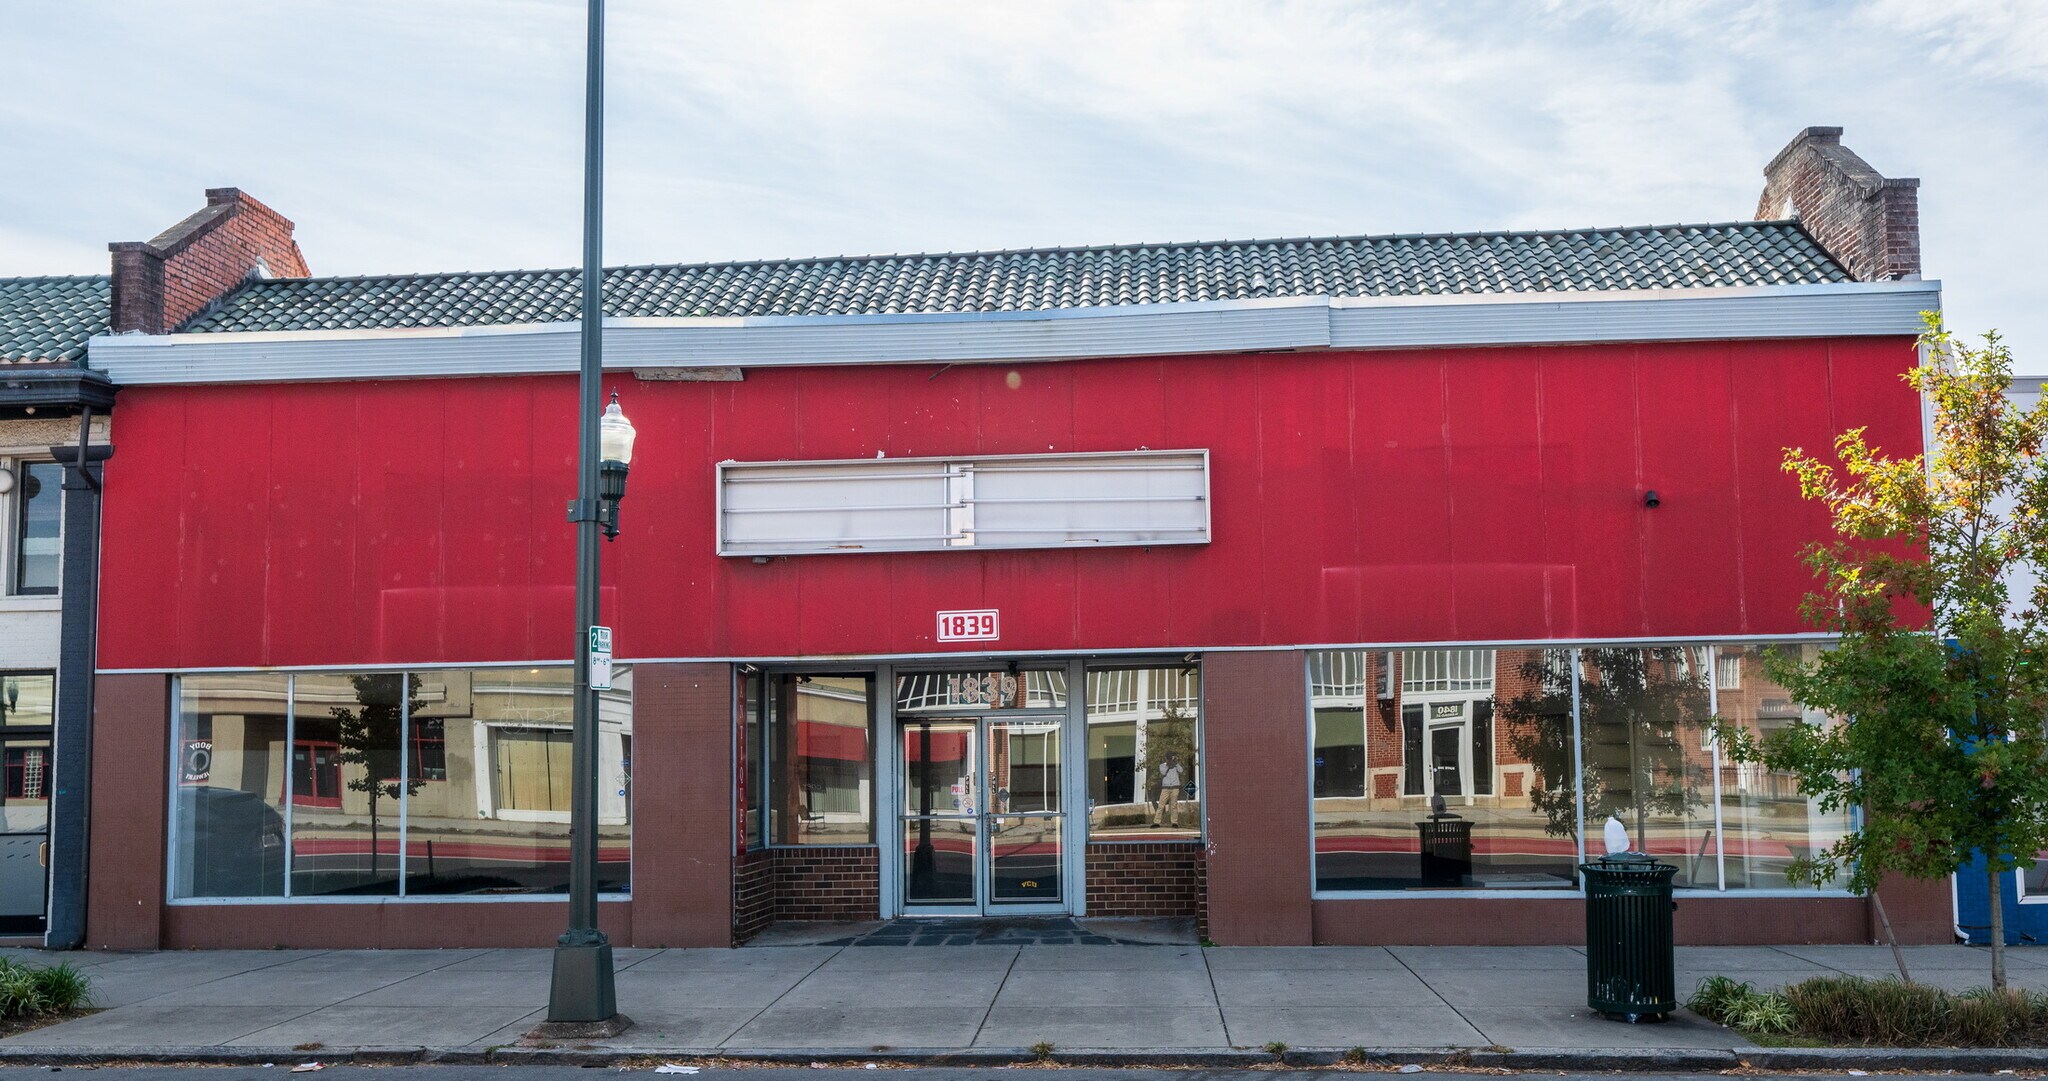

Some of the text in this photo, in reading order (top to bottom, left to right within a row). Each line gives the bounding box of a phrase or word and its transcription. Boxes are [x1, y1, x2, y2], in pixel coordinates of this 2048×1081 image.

[942, 615, 994, 636] 1839
[592, 632, 598, 648] 2
[948, 676, 1017, 703] 1839
[1021, 880, 1037, 888] VCU
